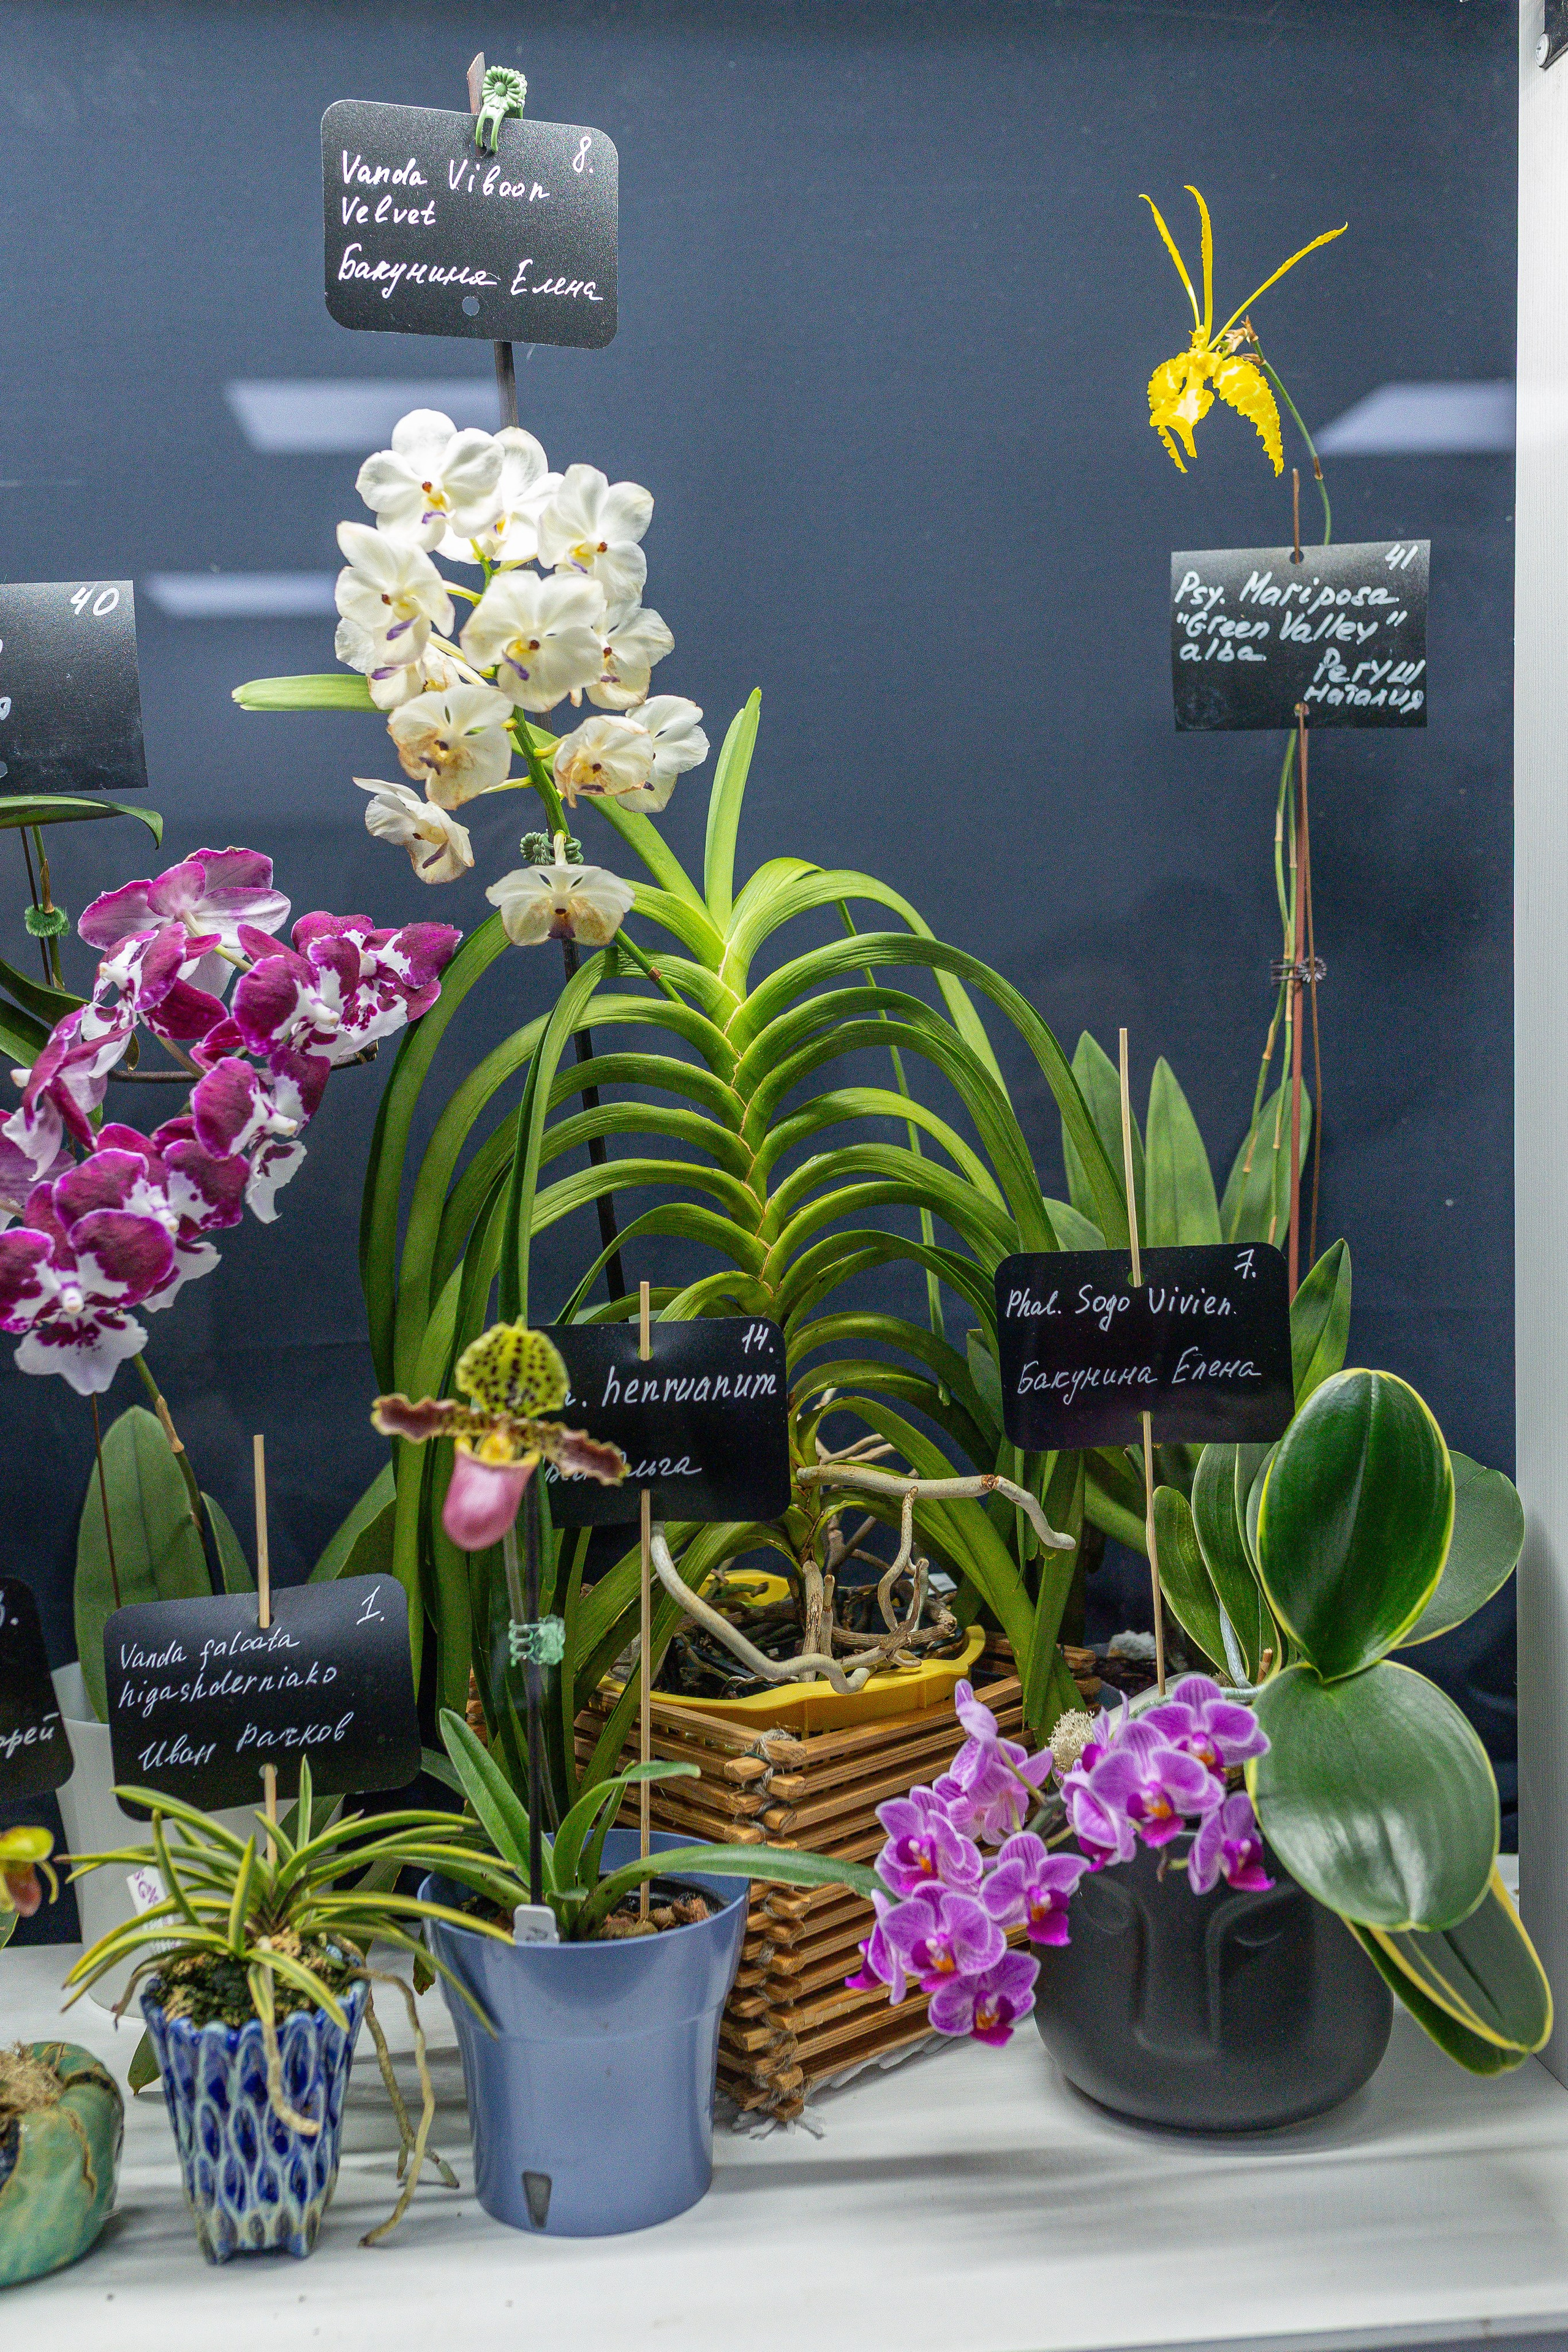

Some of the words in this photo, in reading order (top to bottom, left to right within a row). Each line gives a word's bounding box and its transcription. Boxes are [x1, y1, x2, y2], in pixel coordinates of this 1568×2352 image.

[342, 150, 428, 186] Vanda
[572, 134, 594, 173] 8.
[342, 195, 436, 225] Velvet
[510, 259, 603, 301] Елена
[1385, 543, 1419, 570] 41
[70, 586, 120, 616] 40
[1174, 570, 1225, 611] Psy.
[1238, 570, 1400, 615] Mariposa
[1234, 1248, 1257, 1280] 7.
[1006, 1287, 1061, 1317] Phal.
[1075, 1284, 1131, 1332] Sogo
[741, 1324, 774, 1354] 14.
[1017, 1360, 1158, 1406] Бакунина
[1171, 1346, 1262, 1384] Елена
[356, 1585, 385, 1625] 1.
[120, 1640, 187, 1670] Vanda
[138, 1734, 216, 1771] Иван
